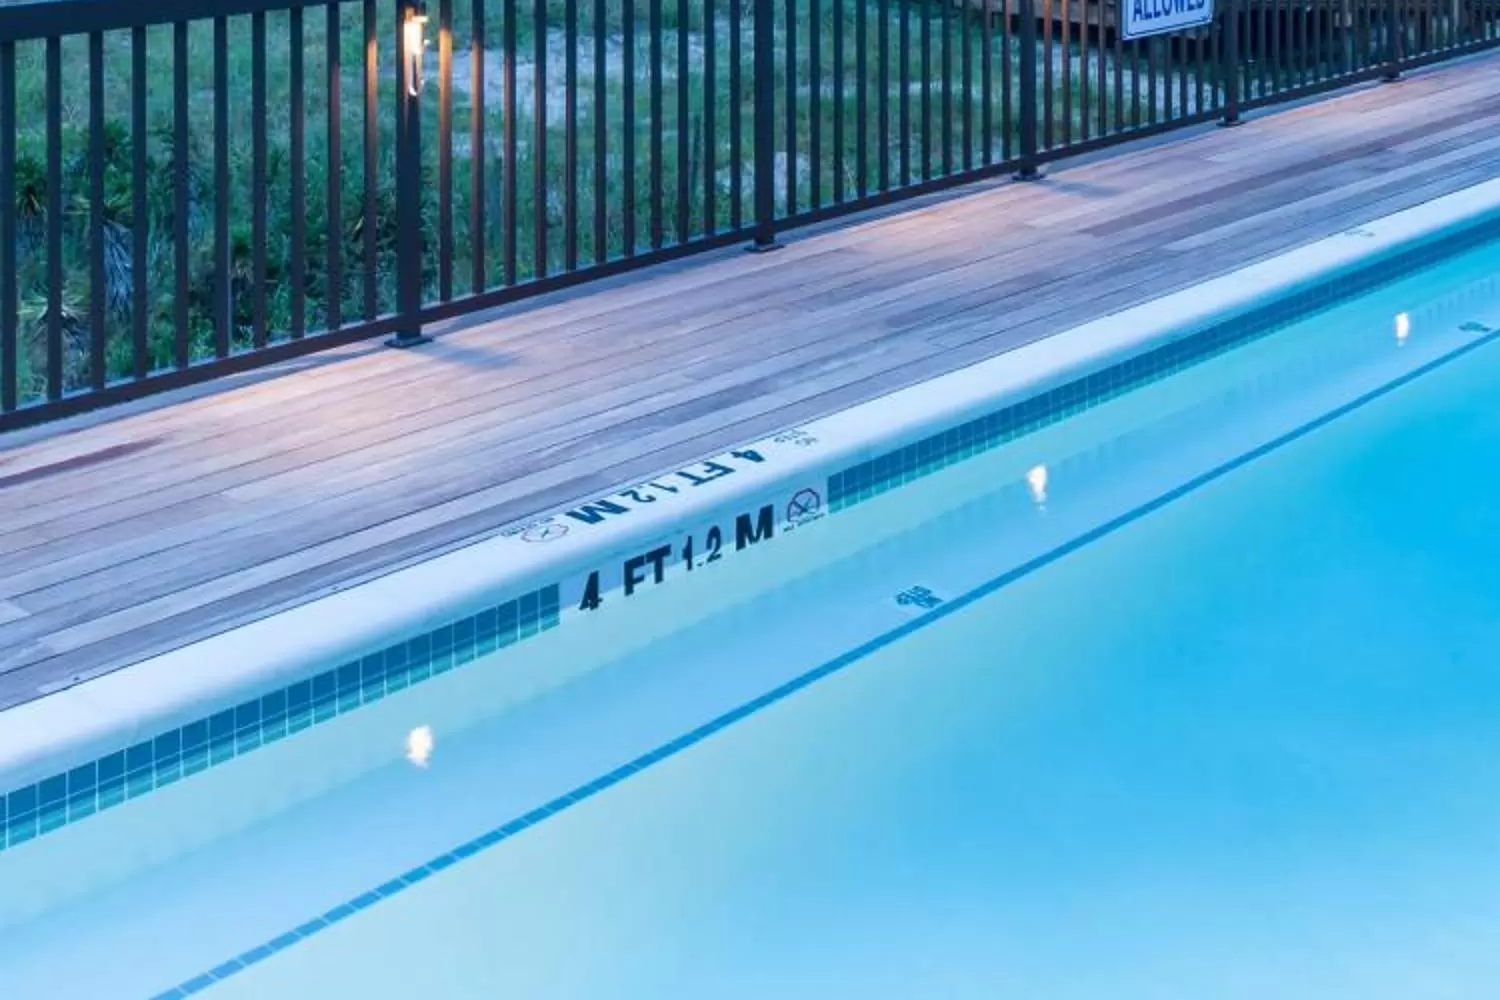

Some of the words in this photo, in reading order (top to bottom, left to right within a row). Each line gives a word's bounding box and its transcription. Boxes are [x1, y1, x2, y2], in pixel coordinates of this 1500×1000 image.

[728, 449, 767, 464] 4
[676, 461, 737, 487] FT
[565, 499, 630, 525] M
[579, 570, 603, 611] 4
[623, 544, 672, 597] FT
[735, 504, 774, 551] M
